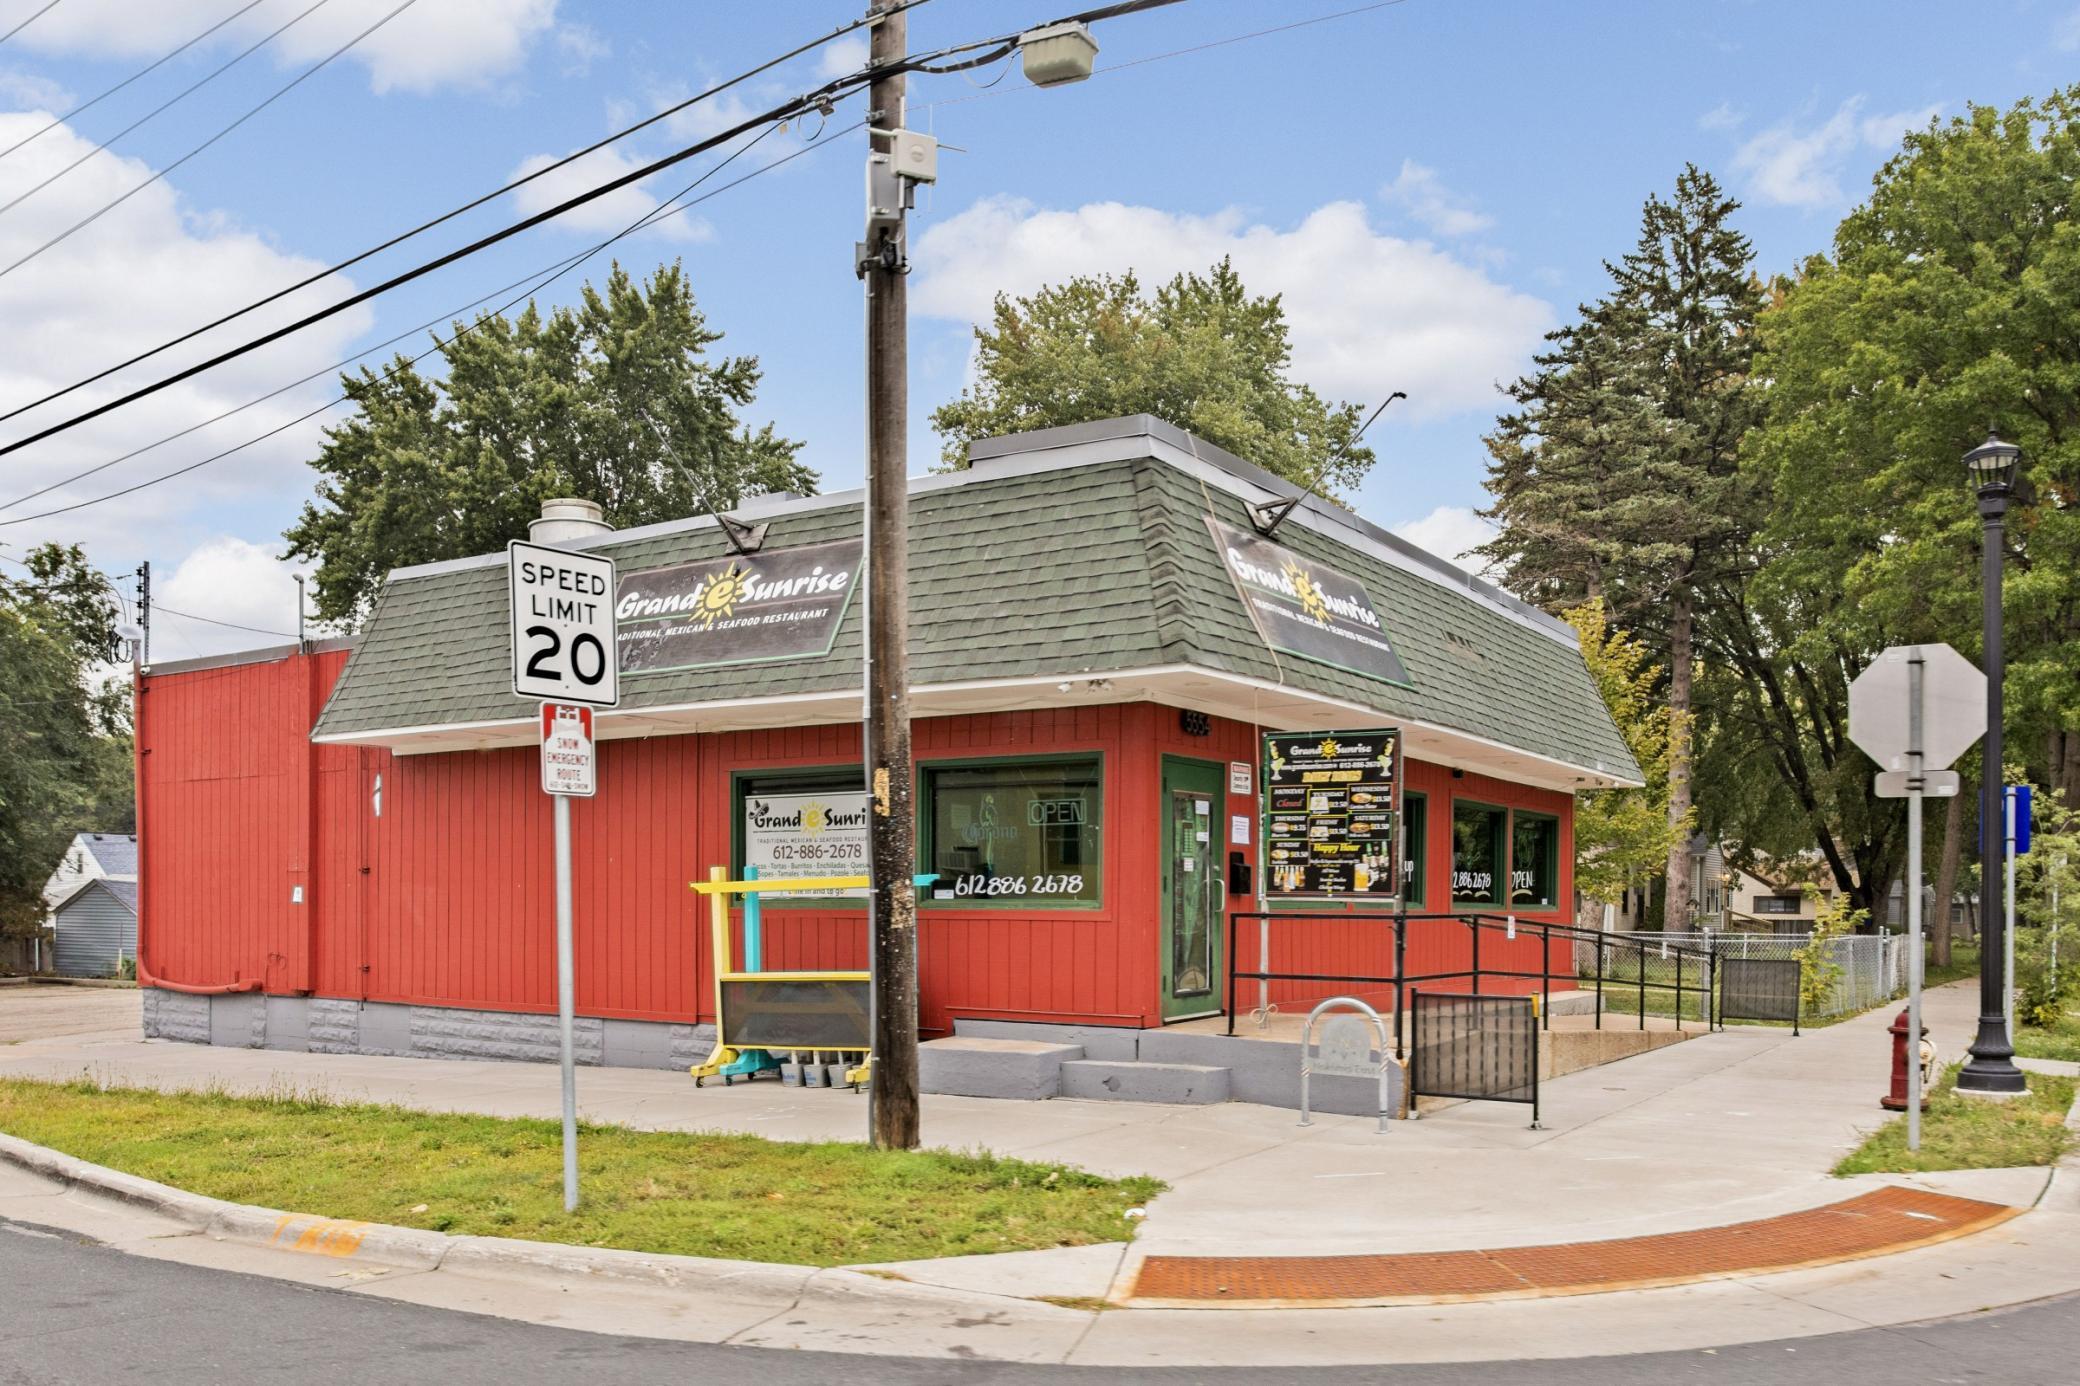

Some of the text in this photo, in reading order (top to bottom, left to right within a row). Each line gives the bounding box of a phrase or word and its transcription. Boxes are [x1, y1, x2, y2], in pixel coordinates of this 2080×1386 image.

[522, 562, 606, 596] SPEED
[739, 566, 849, 604] Sunrise
[532, 593, 598, 625] LIMIT
[617, 629, 661, 641] ADITIONAL
[664, 624, 706, 636] MEXICAN
[717, 616, 761, 630] SEAFOOD
[763, 608, 829, 624] RESTAURANT
[526, 625, 606, 686] 20
[824, 807, 867, 827] Sunri
[1031, 802, 1085, 823] OPEN
[773, 843, 863, 860] 612-886-2678
[1031, 873, 1084, 895] 2678
